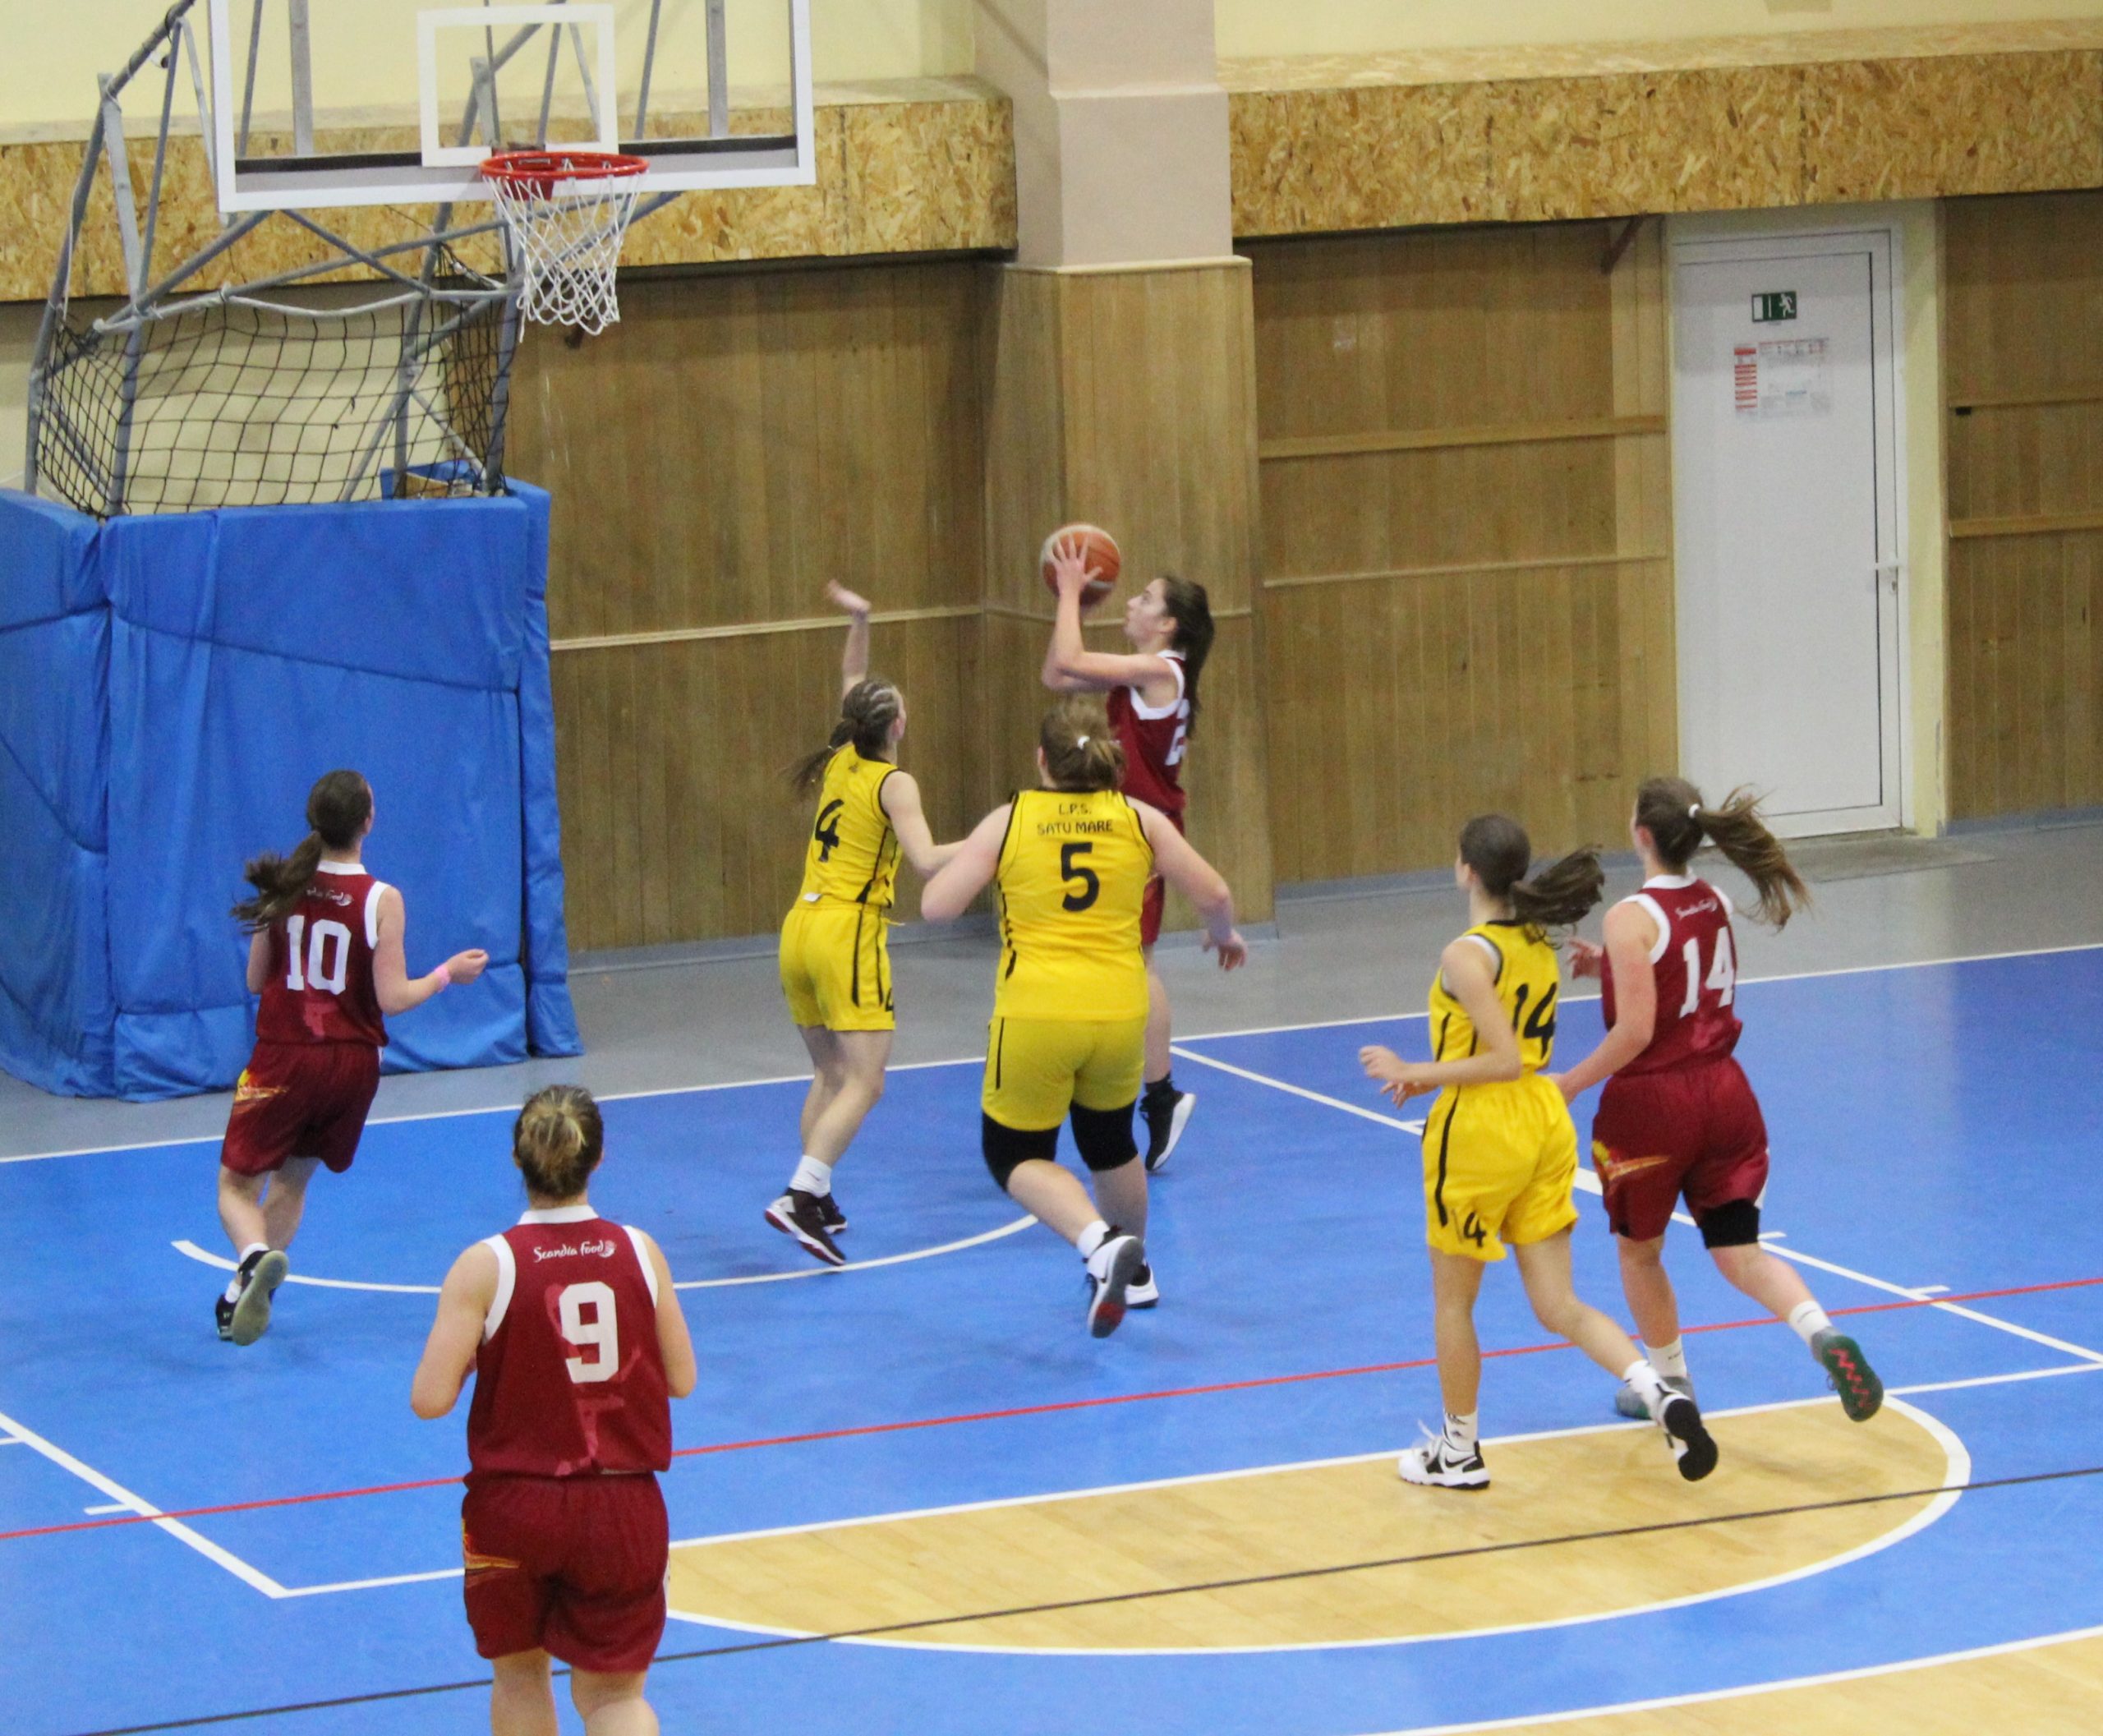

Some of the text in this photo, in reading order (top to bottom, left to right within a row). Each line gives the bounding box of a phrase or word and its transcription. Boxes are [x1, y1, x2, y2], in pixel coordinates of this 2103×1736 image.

[815, 799, 844, 863] 4
[1037, 819, 1113, 836] SATU MARE
[1058, 804, 1092, 815] L.P.S.
[1061, 841, 1100, 914] 5
[287, 914, 352, 995] 10
[1678, 925, 1735, 1019] 14
[1512, 982, 1557, 1060] 14
[533, 1243, 578, 1263] Scandia
[559, 1281, 619, 1384] 9
